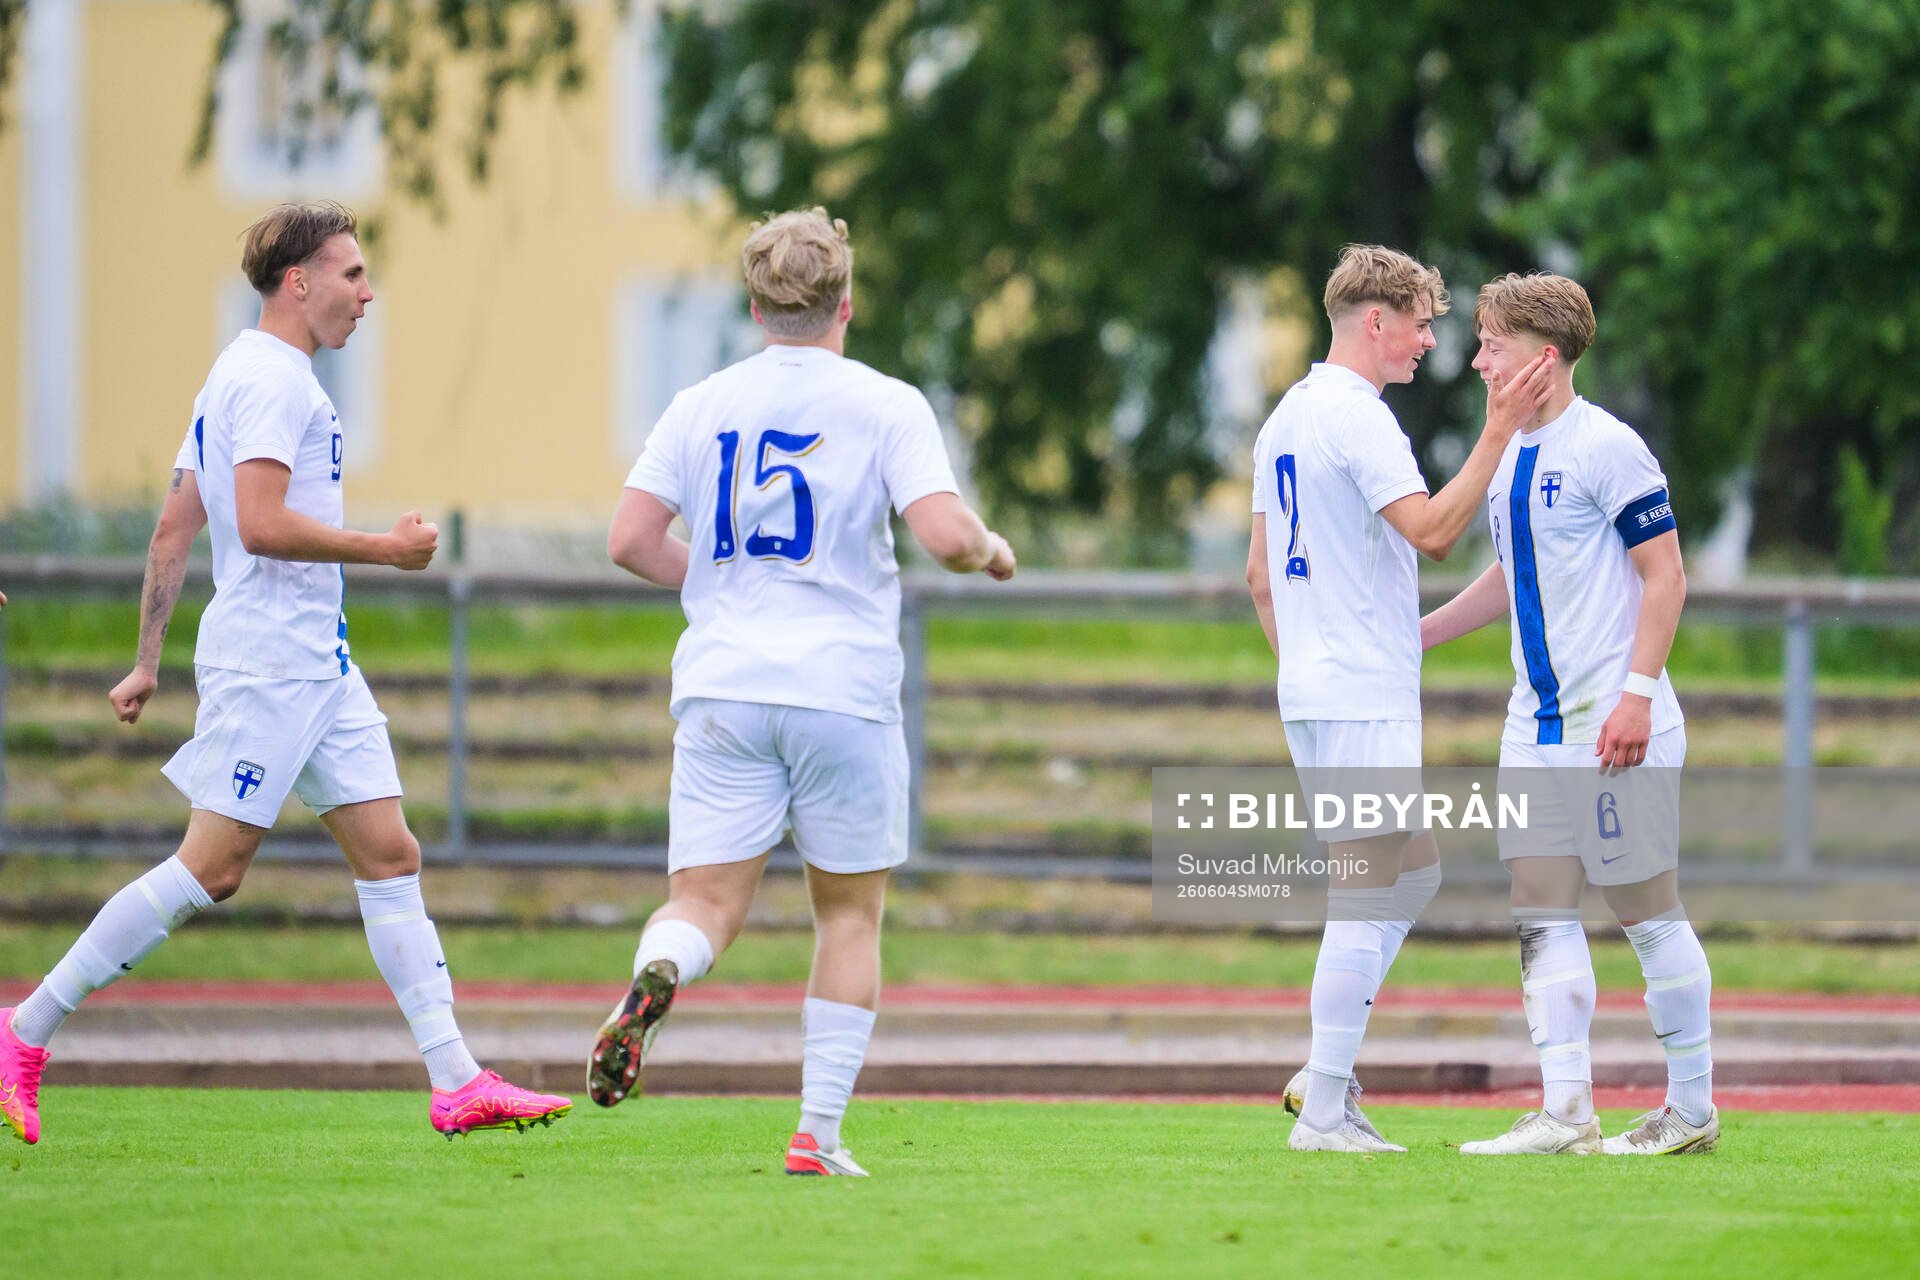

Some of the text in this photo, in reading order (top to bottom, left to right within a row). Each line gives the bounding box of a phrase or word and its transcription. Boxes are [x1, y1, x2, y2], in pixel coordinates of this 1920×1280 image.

[331, 432, 343, 483] 9
[713, 429, 824, 567] 15
[1275, 453, 1311, 585] 2
[1596, 791, 1624, 841] 6
